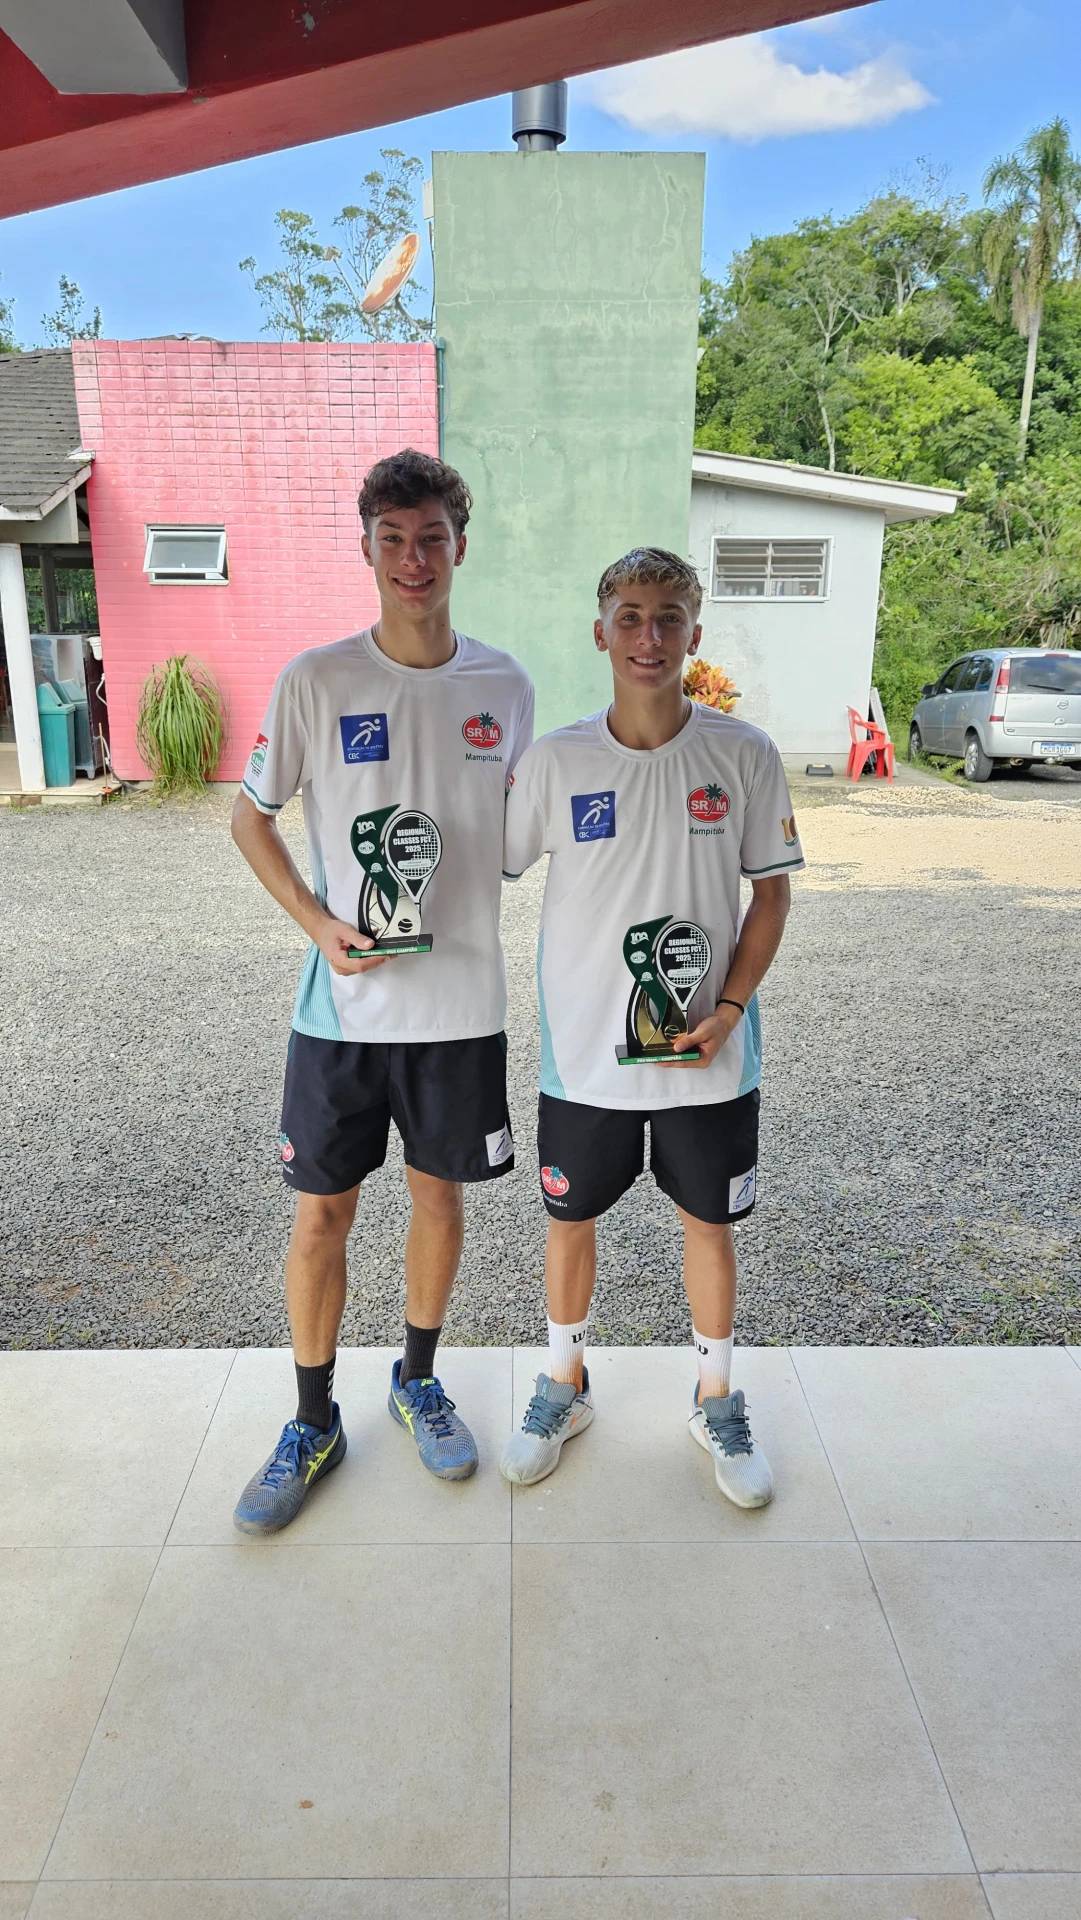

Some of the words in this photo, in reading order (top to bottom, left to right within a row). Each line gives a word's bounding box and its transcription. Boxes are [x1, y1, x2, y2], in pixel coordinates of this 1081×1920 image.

[465, 753, 503, 763] Mampituba
[396, 828, 426, 837] REGIONAL
[392, 837, 419, 846] CLASSES
[420, 836, 431, 844] FCT
[404, 845, 422, 853] 2025
[668, 938, 697, 947] REGIONAL
[664, 947, 690, 955] CLASSES
[675, 954, 692, 963] 2025
